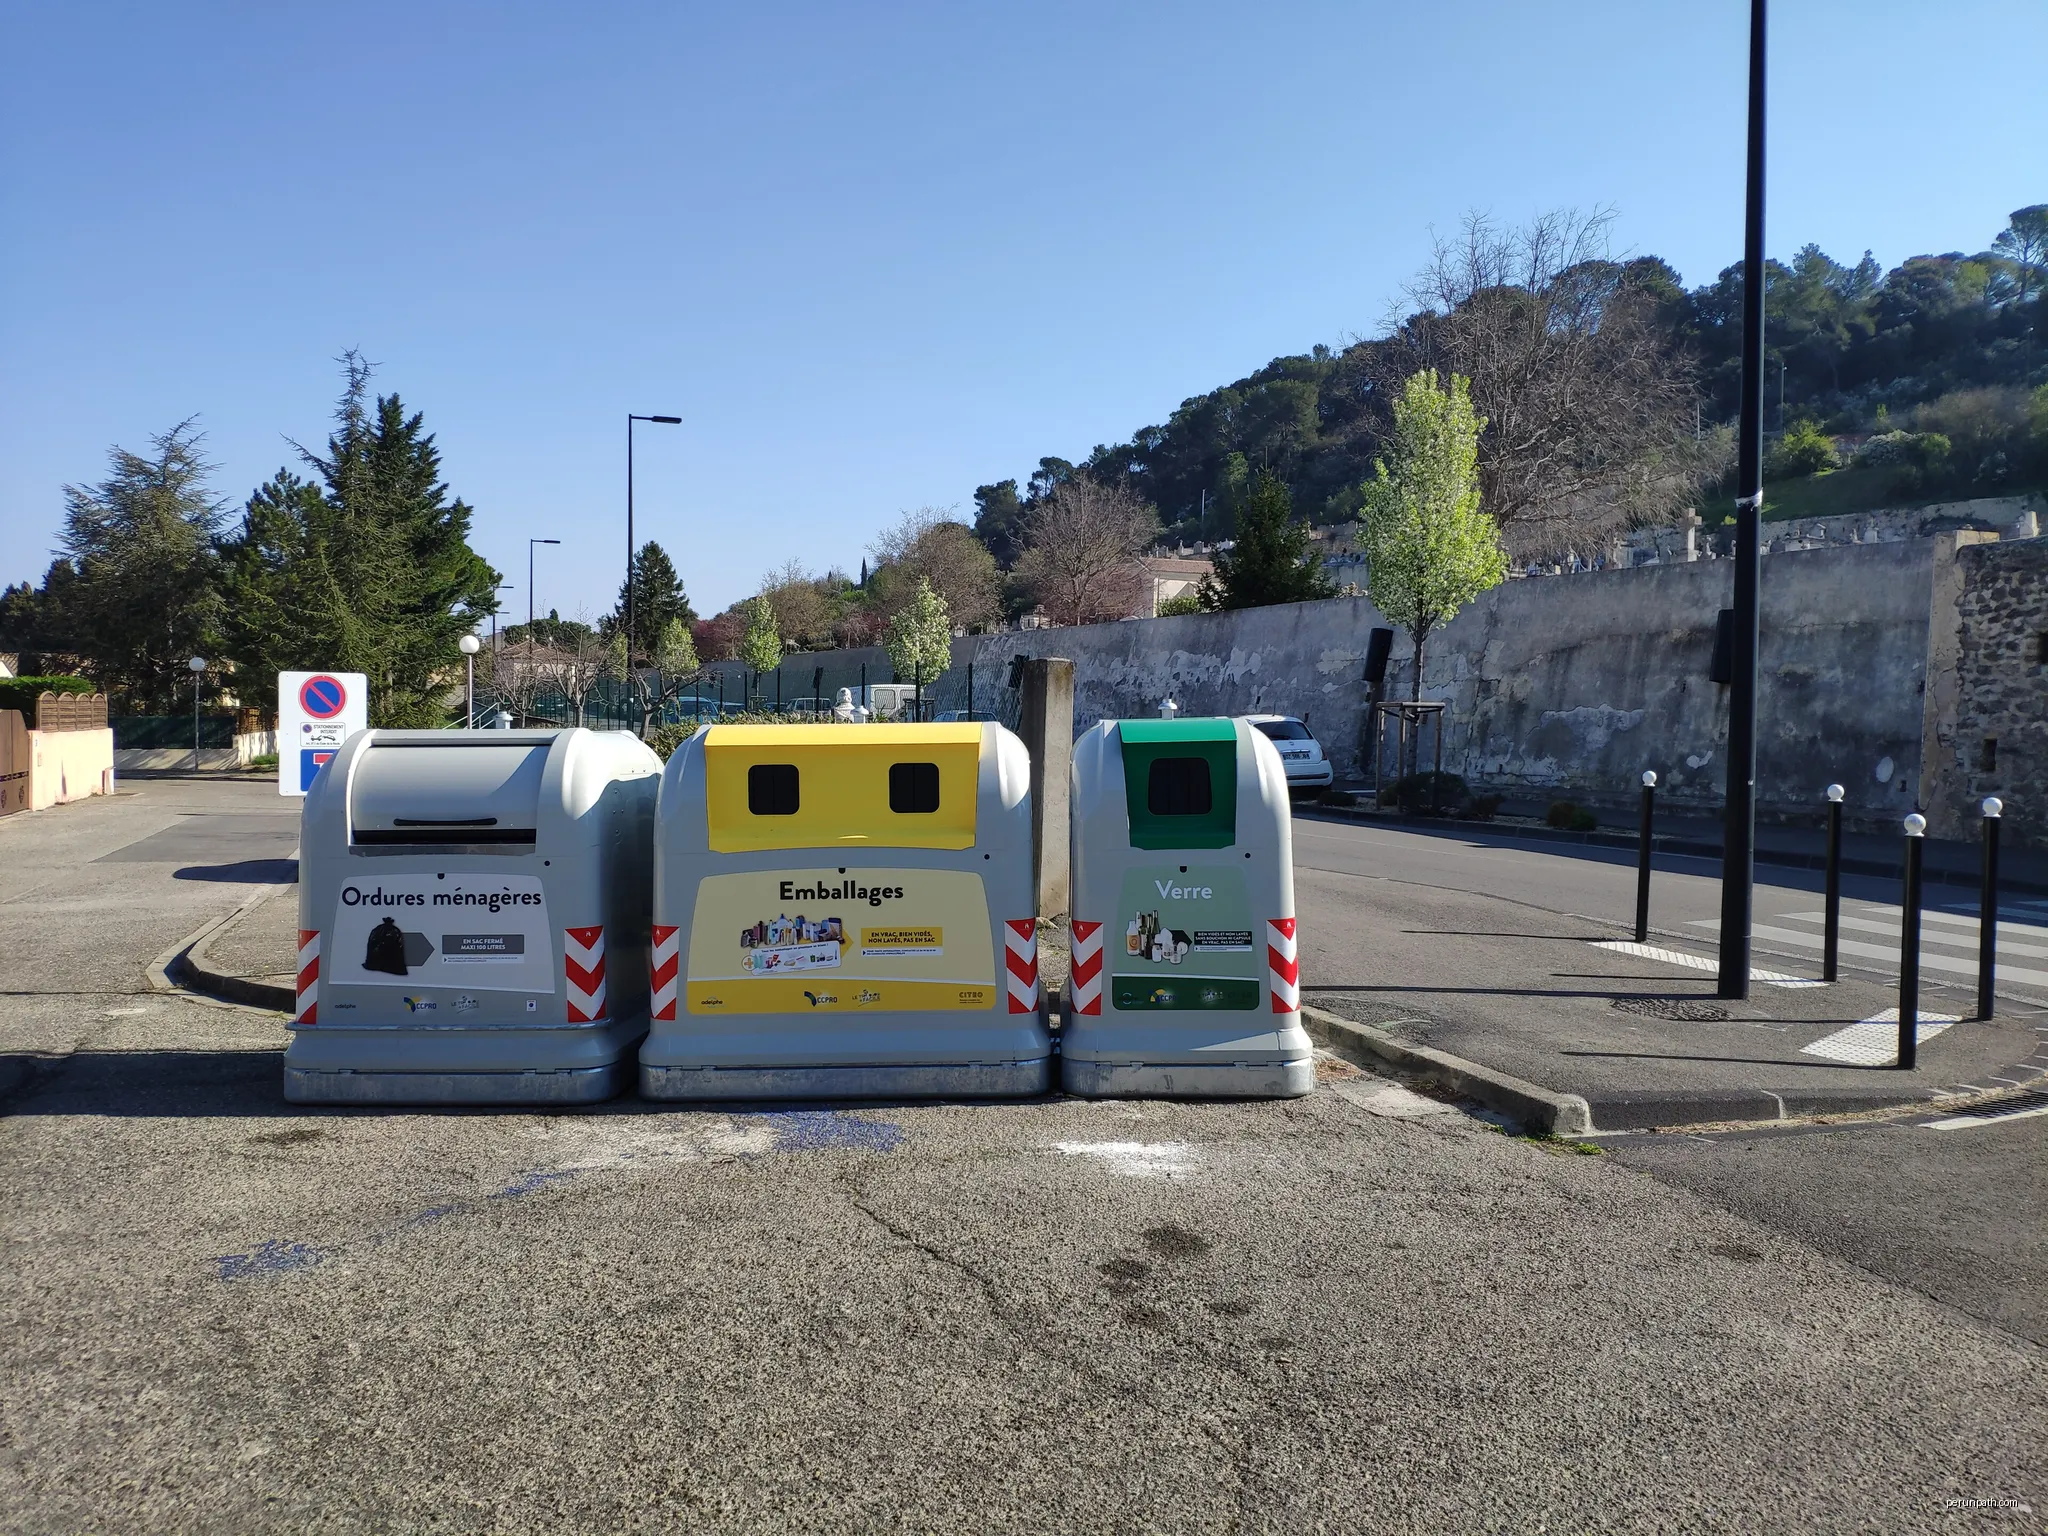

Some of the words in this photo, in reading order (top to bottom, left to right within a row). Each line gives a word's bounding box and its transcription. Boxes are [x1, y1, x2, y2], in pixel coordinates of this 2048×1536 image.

[342, 886, 425, 906] Ordures
[433, 886, 542, 913] ménagères
[779, 880, 904, 906] Emballages
[1154, 879, 1213, 900] Verre
[416, 1002, 437, 1010] CCPRO
[817, 996, 838, 1004] CCPRO
